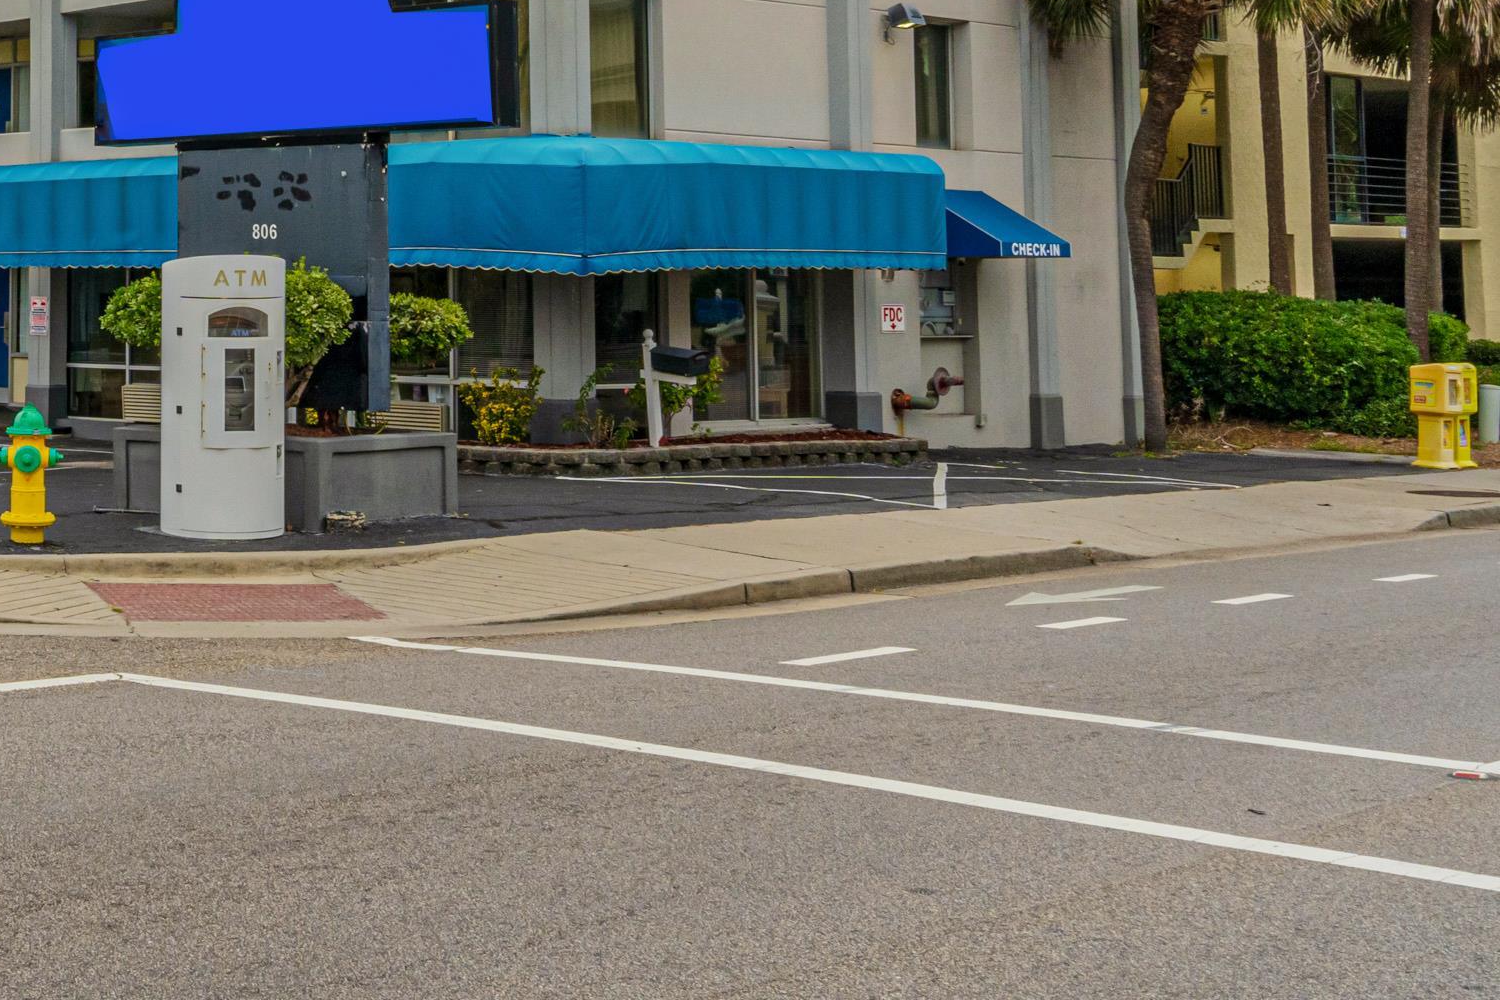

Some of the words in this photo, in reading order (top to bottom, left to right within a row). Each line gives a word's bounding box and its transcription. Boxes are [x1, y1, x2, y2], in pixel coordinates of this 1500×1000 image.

[252, 223, 277, 240] 806
[1011, 242, 1060, 257] CHECK-IN
[213, 269, 267, 287] ATM
[883, 307, 903, 322] FDC
[230, 328, 251, 337] ATM
